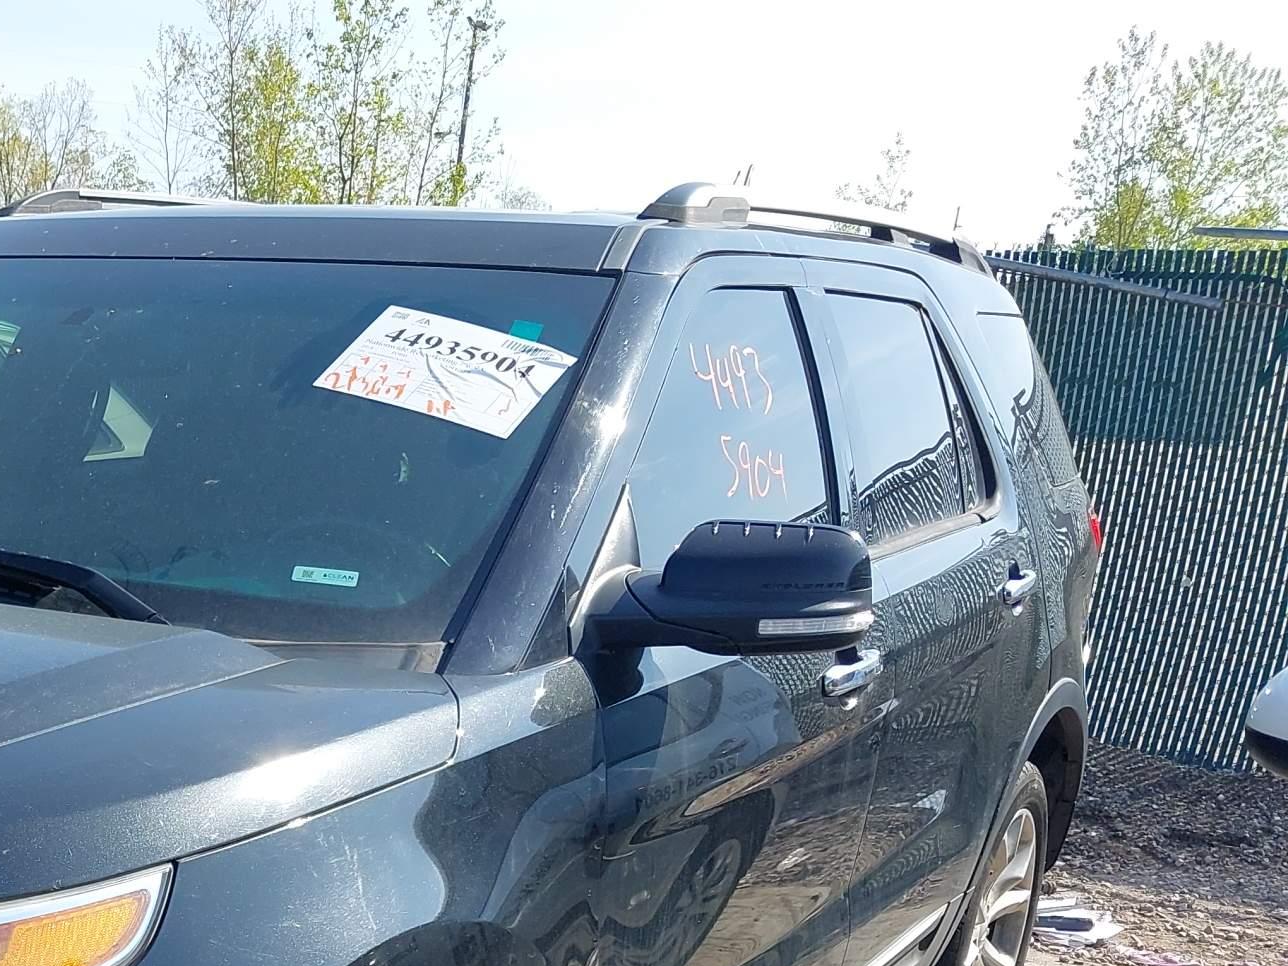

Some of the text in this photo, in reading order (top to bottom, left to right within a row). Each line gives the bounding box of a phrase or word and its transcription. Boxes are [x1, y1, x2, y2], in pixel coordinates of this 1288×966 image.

[383, 328, 536, 378] 44935904
[689, 342, 773, 416] 4493
[720, 434, 789, 503] 5904
